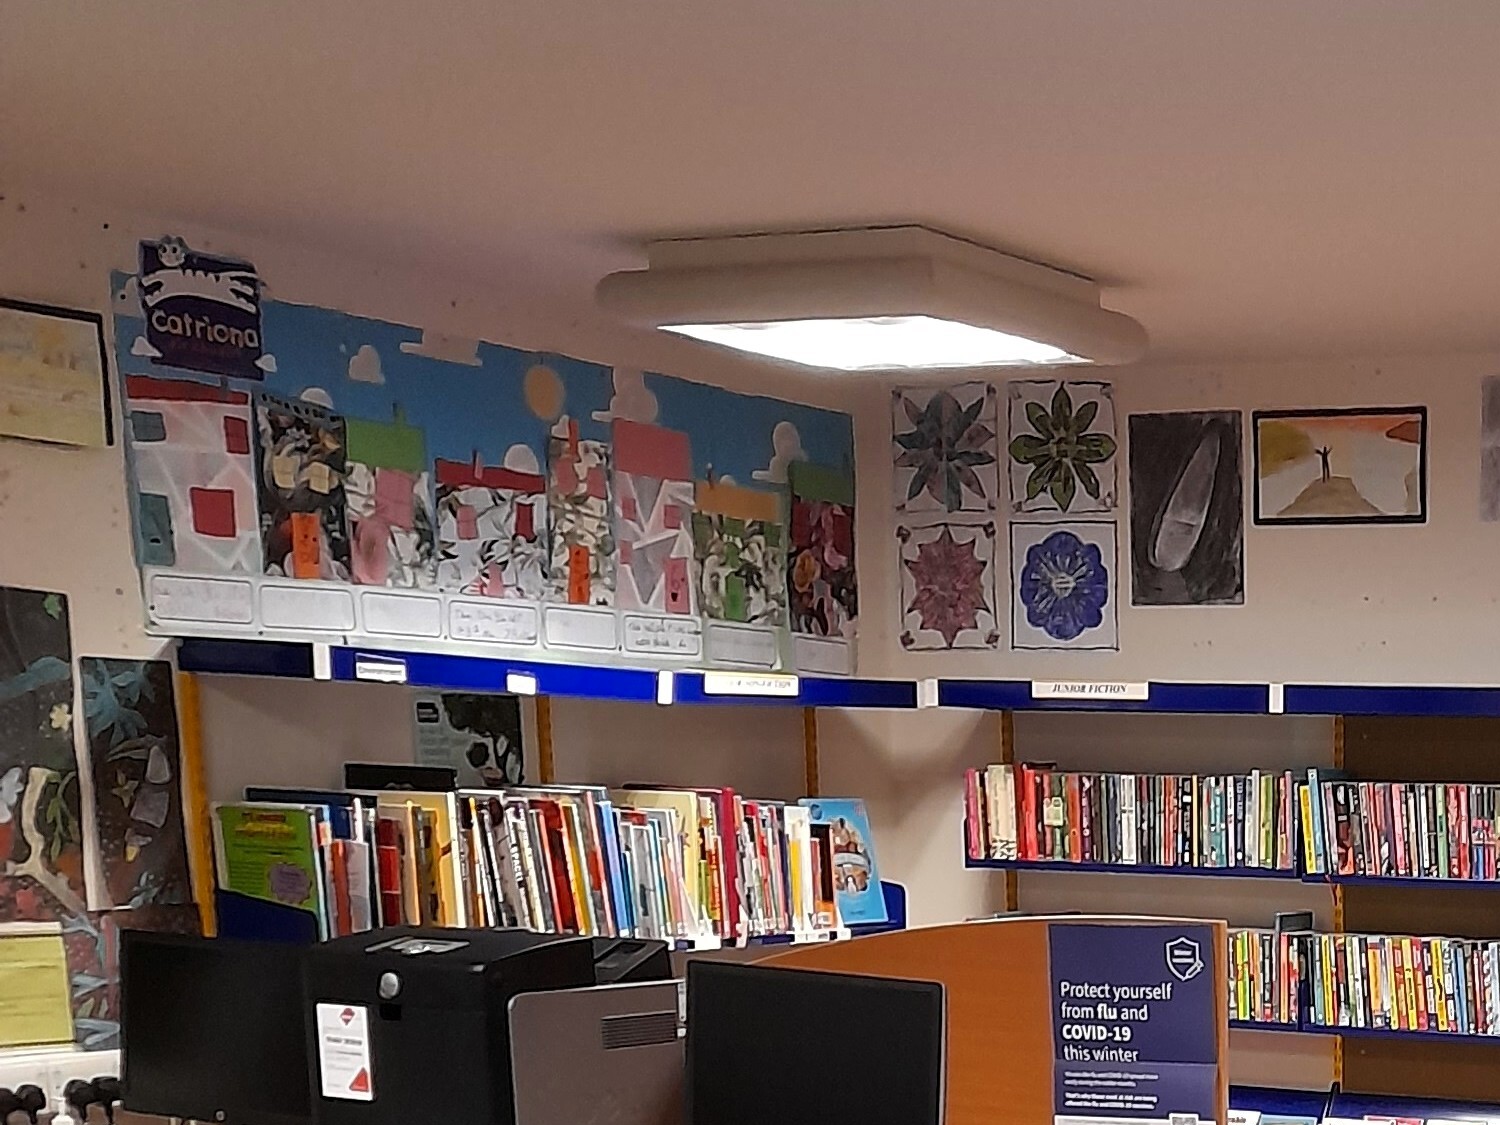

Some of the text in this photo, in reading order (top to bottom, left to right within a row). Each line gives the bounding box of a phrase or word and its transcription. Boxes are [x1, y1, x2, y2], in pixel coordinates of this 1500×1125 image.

[152, 309, 259, 347] Catriona
[1052, 683, 1128, 693] JUNIOR FICTION
[1060, 981, 1173, 1002] Protect yourself
[1061, 1002, 1149, 1021] from flu and
[1062, 1024, 1132, 1041] COVID-19
[1064, 1044, 1138, 1063] this winter
